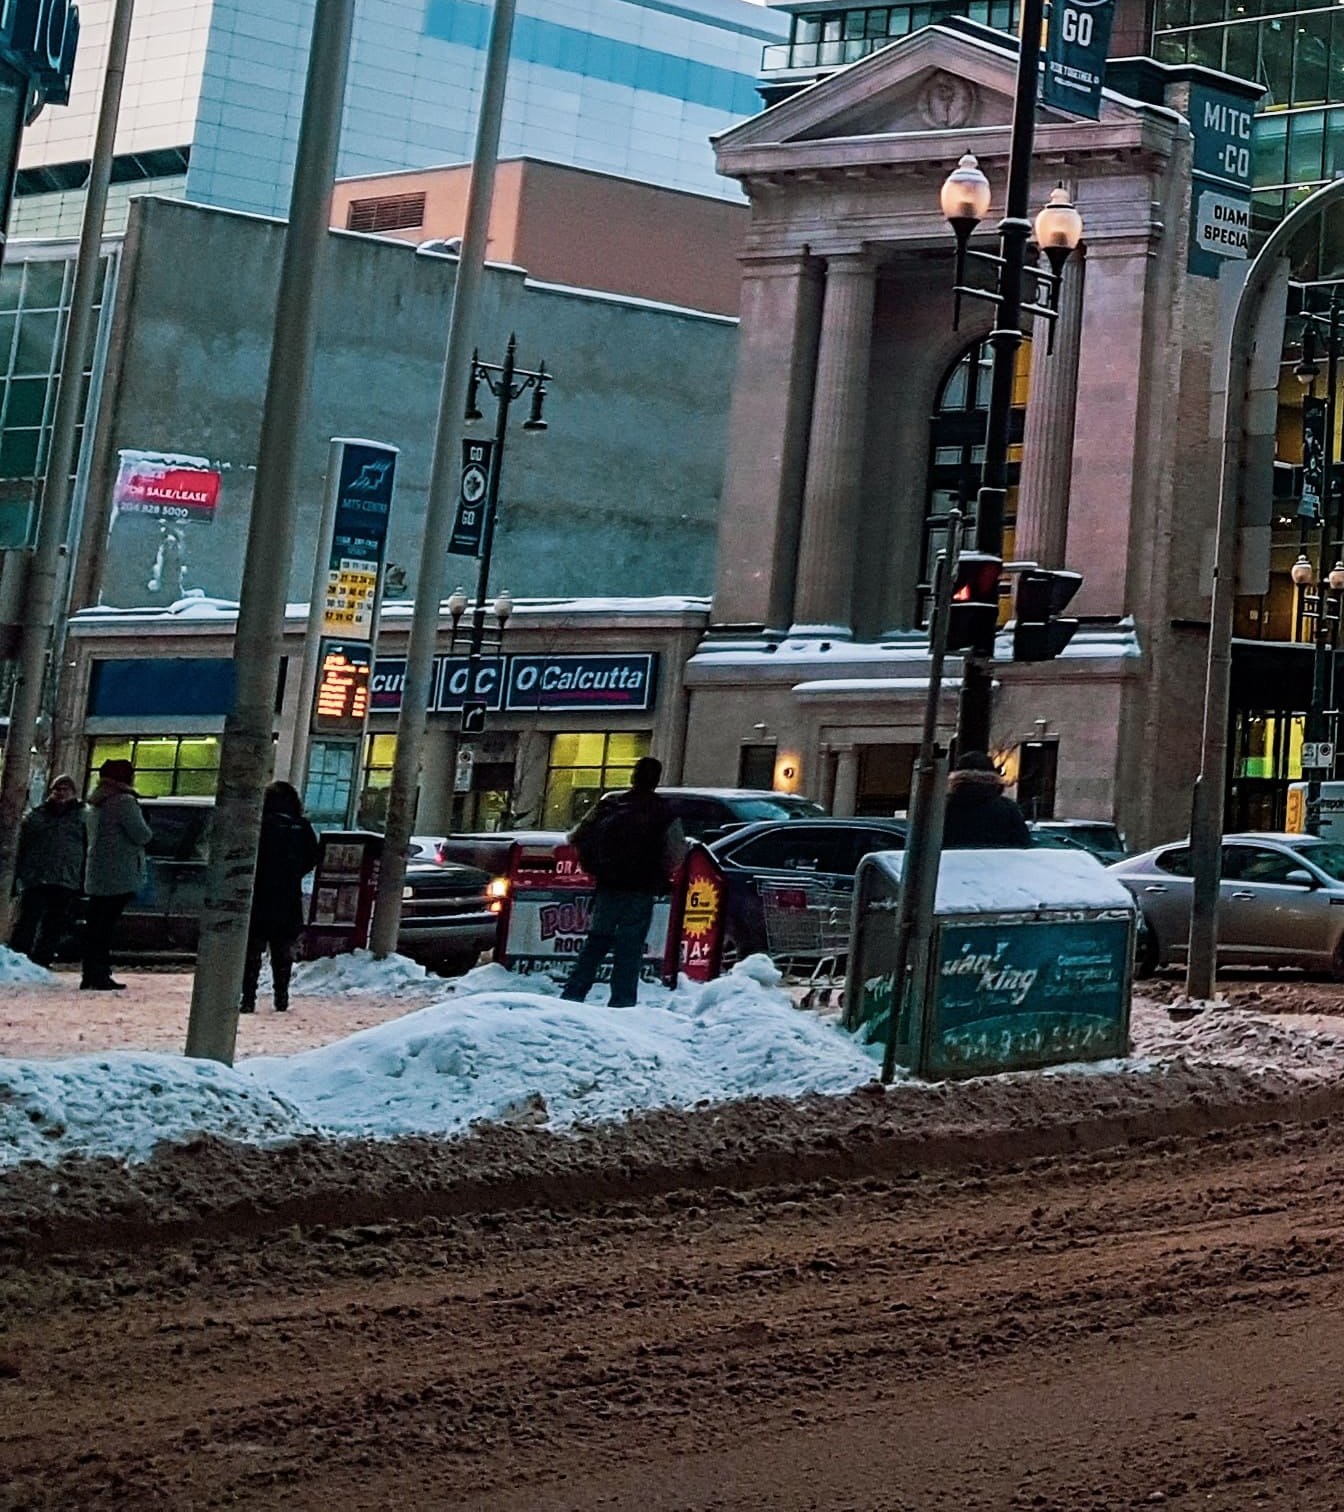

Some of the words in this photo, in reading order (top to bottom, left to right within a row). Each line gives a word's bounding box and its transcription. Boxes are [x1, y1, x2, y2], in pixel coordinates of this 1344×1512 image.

[1062, 8, 1093, 47] GO
[1204, 101, 1250, 140] MITC
[1214, 204, 1248, 227] DIAM
[1204, 224, 1249, 250] SPECIA
[470, 446, 484, 462] GO
[146, 487, 208, 503] SALE/LEASE
[461, 510, 475, 526] GO
[515, 667, 537, 691] O
[541, 665, 643, 691] Calcutta
[690, 892, 700, 908] 6
[689, 941, 711, 958] A+
